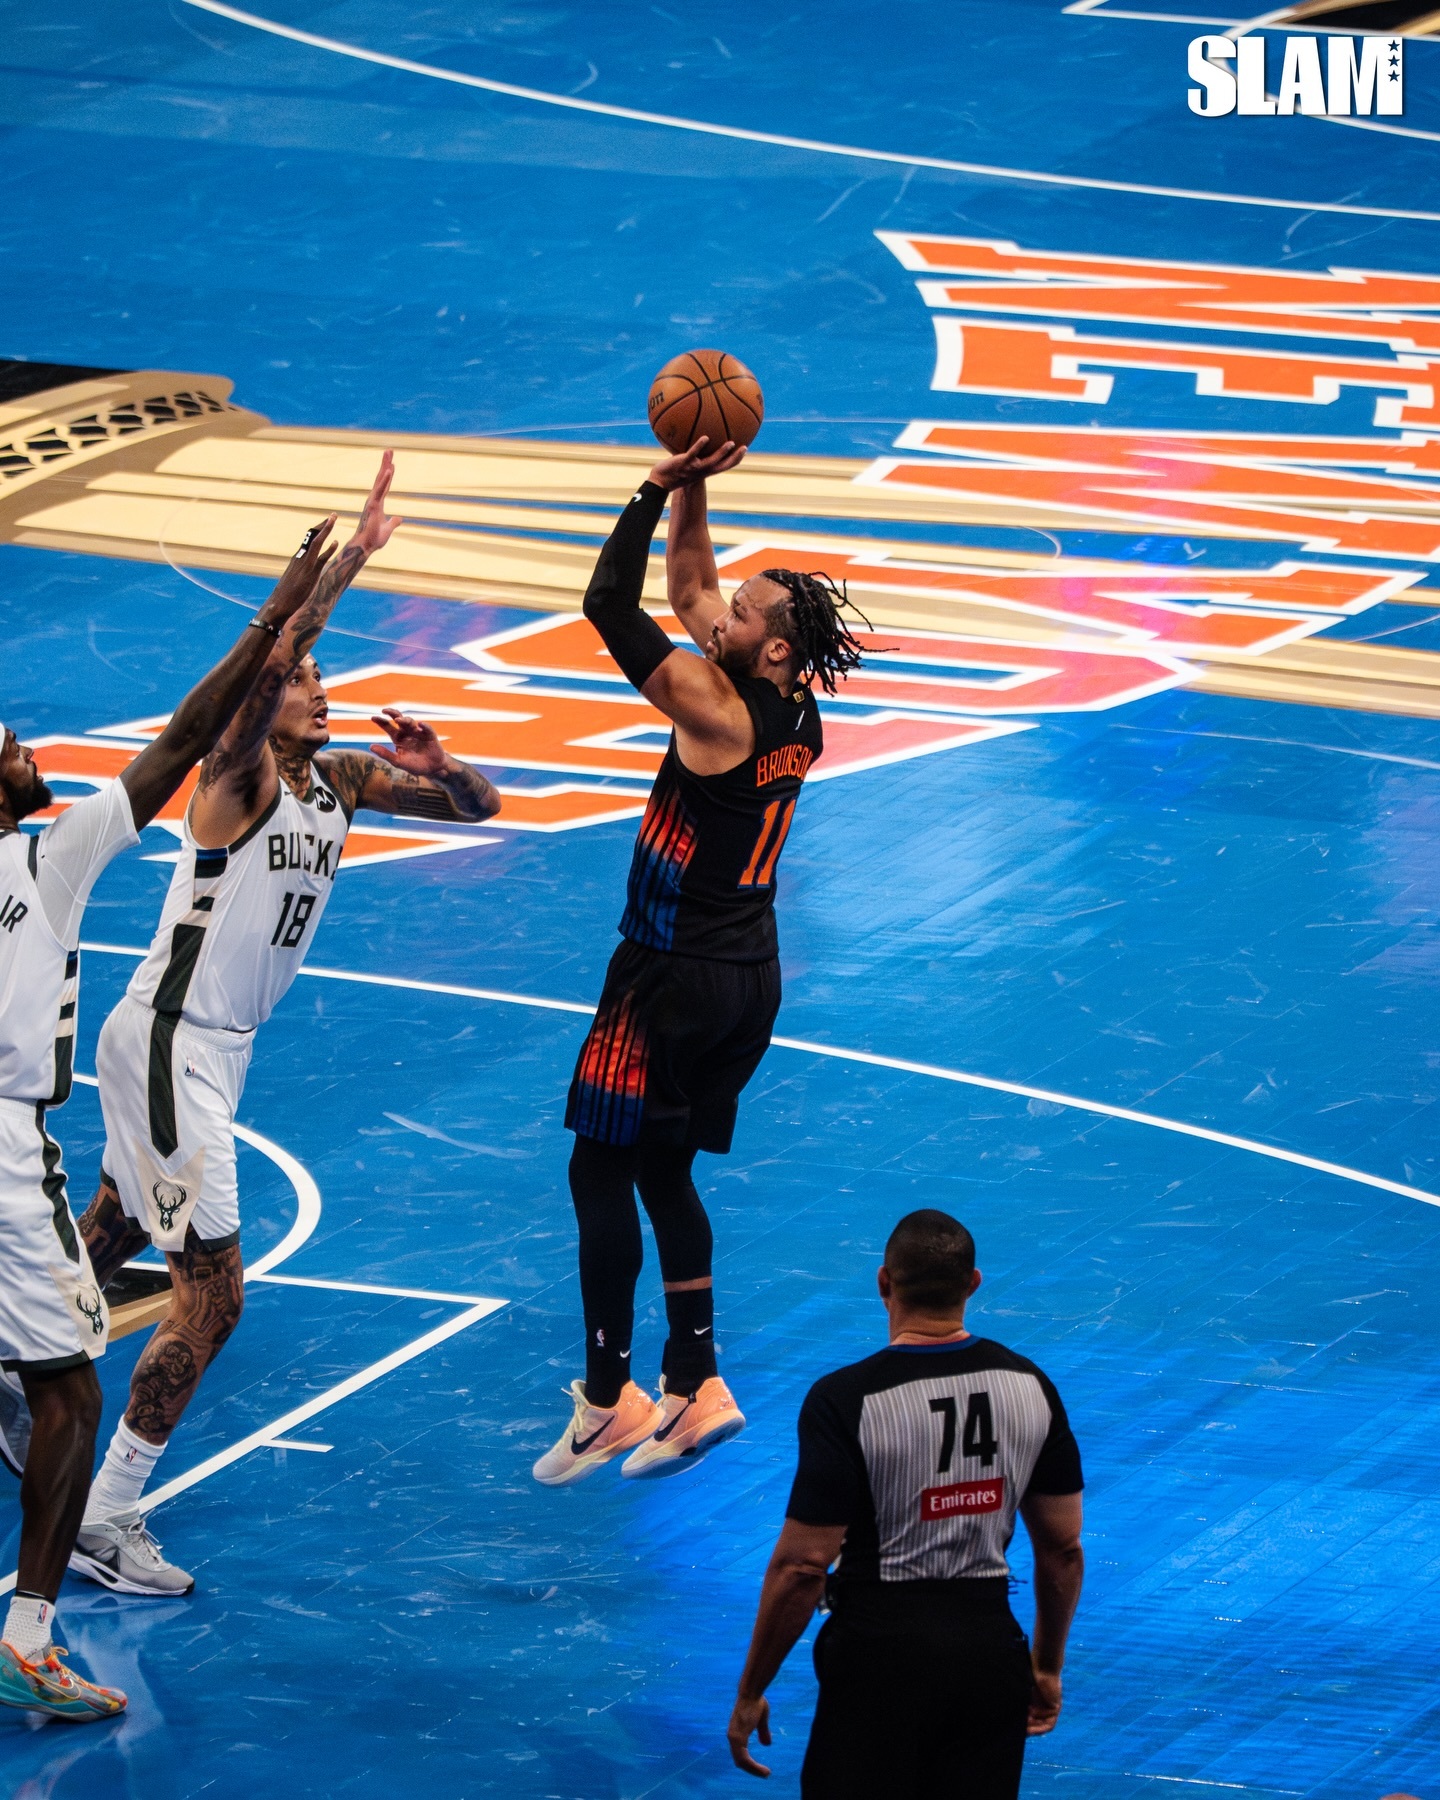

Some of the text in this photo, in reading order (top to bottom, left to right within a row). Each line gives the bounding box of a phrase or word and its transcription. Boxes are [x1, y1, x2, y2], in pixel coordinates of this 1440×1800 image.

[851, 230, 1440, 563] NEW
[737, 798, 797, 889] 11
[271, 892, 317, 947] 18
[928, 1391, 998, 1473] 74
[930, 1489, 997, 1512] Emirates
